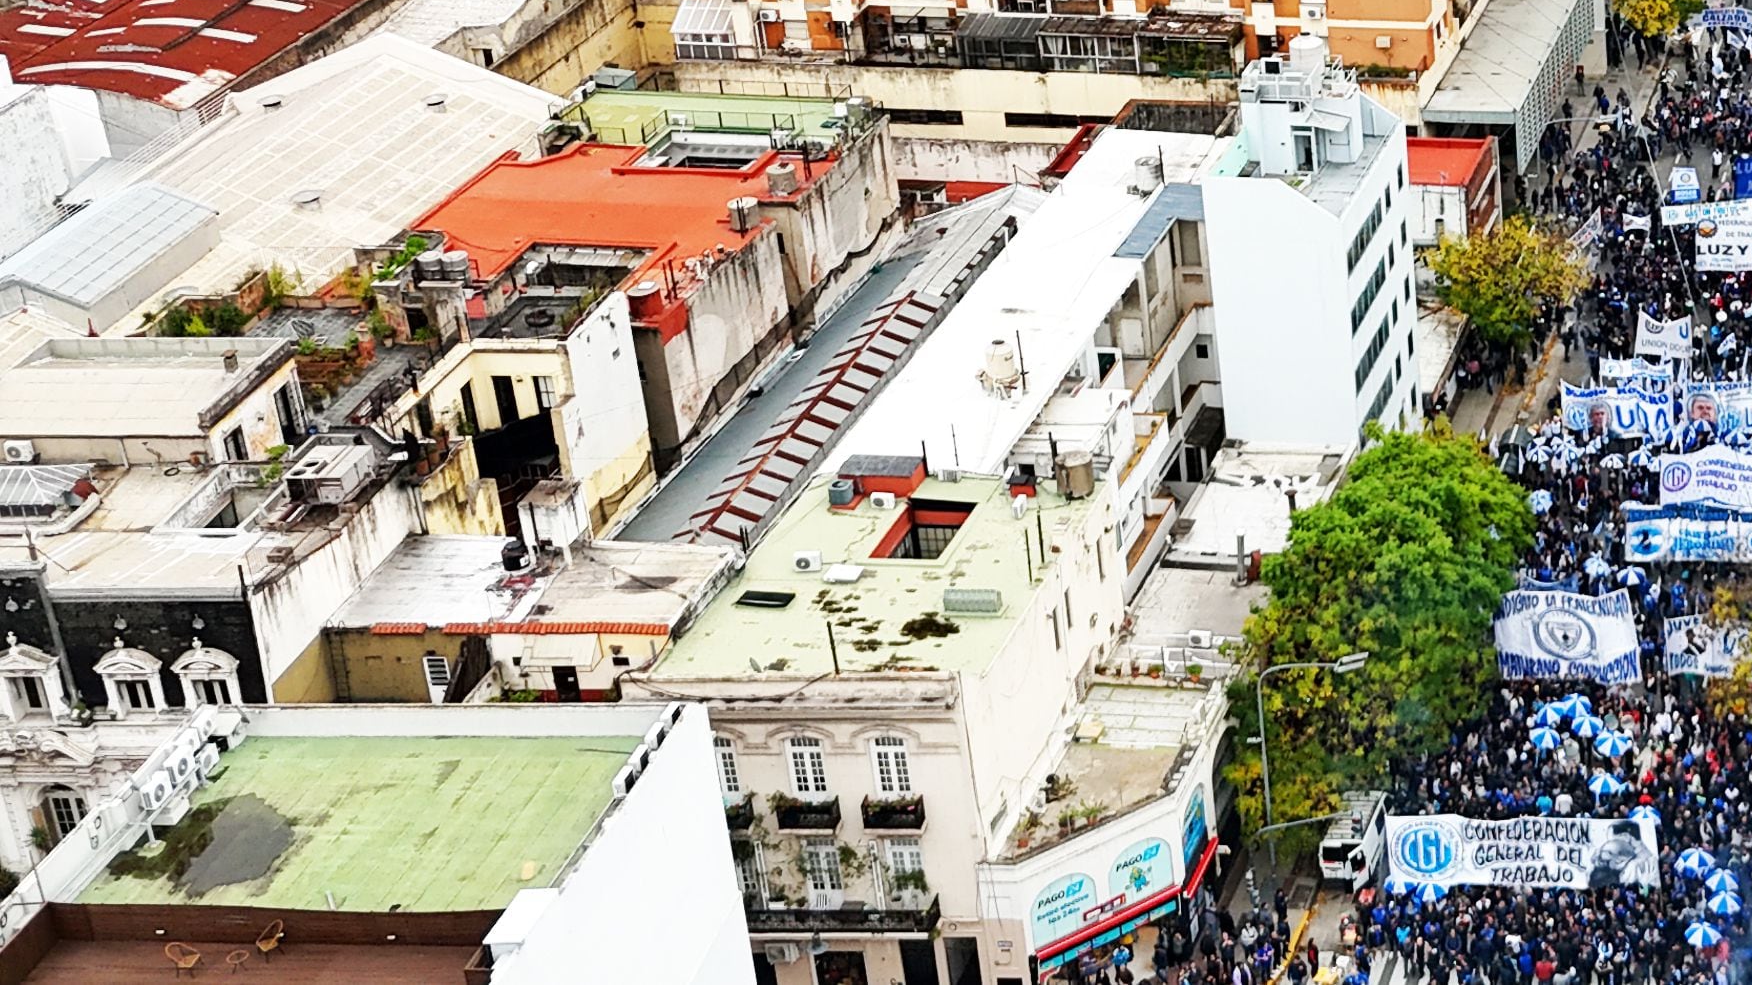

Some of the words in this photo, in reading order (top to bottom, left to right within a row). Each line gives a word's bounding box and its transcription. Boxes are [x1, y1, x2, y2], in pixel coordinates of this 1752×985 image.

[1702, 14, 1748, 22] CALZADO
[1697, 245, 1734, 256] LUZ
[1736, 245, 1749, 256] Y
[1641, 338, 1668, 349] UNION
[1695, 479, 1738, 492] TRABAJO
[1545, 595, 1557, 608] LA
[1464, 819, 1592, 843] CONFEDERACION
[1116, 853, 1143, 873] PAGO
[1474, 844, 1544, 866] GENERAL
[1557, 845, 1586, 867] DEL
[1490, 866, 1574, 884] TRABAJO
[1037, 890, 1065, 910] PAGO
